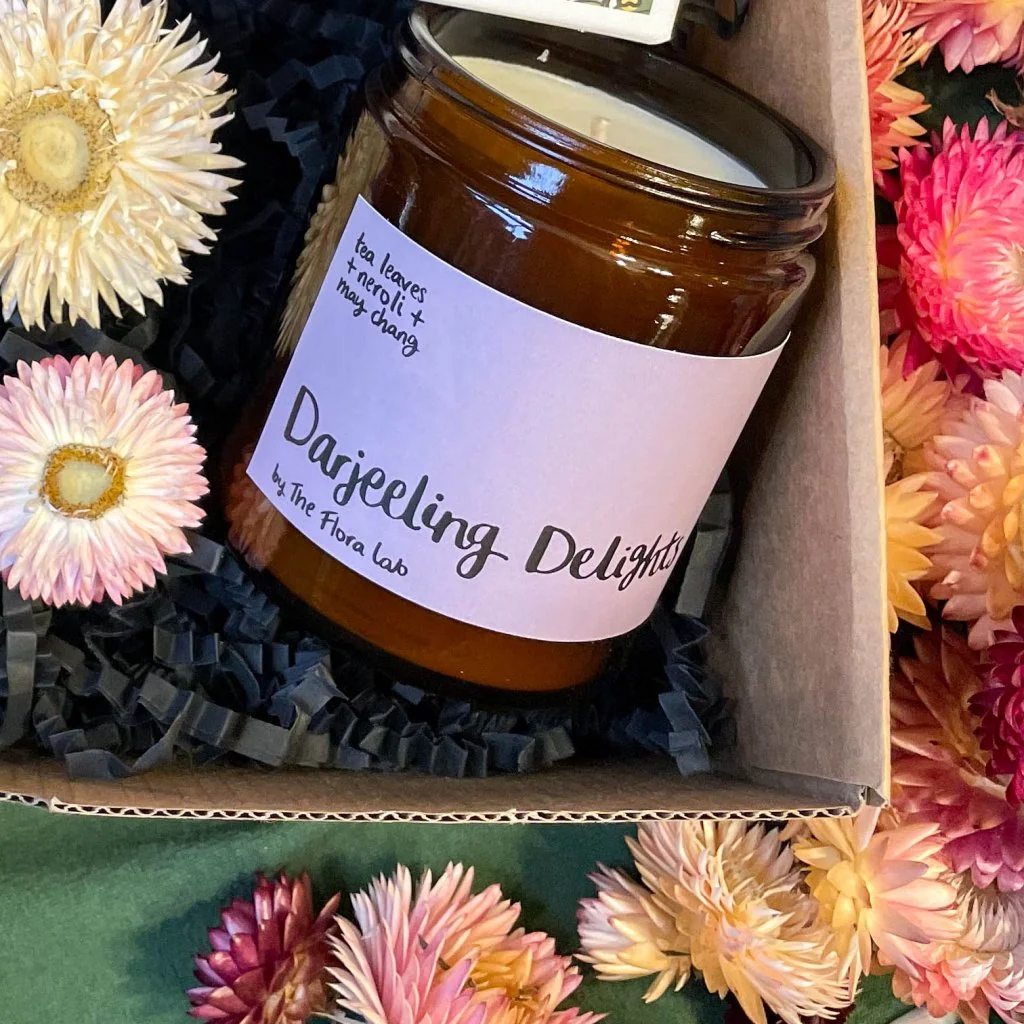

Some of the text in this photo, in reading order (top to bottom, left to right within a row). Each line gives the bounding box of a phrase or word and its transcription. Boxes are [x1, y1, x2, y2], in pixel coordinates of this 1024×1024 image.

[355, 232, 427, 304] tea leaves
[336, 277, 420, 358] may chang
[271, 463, 286, 498] by
[287, 480, 315, 517] The
[320, 510, 365, 557] Flora
[283, 385, 685, 592] Darjeeling Delights
